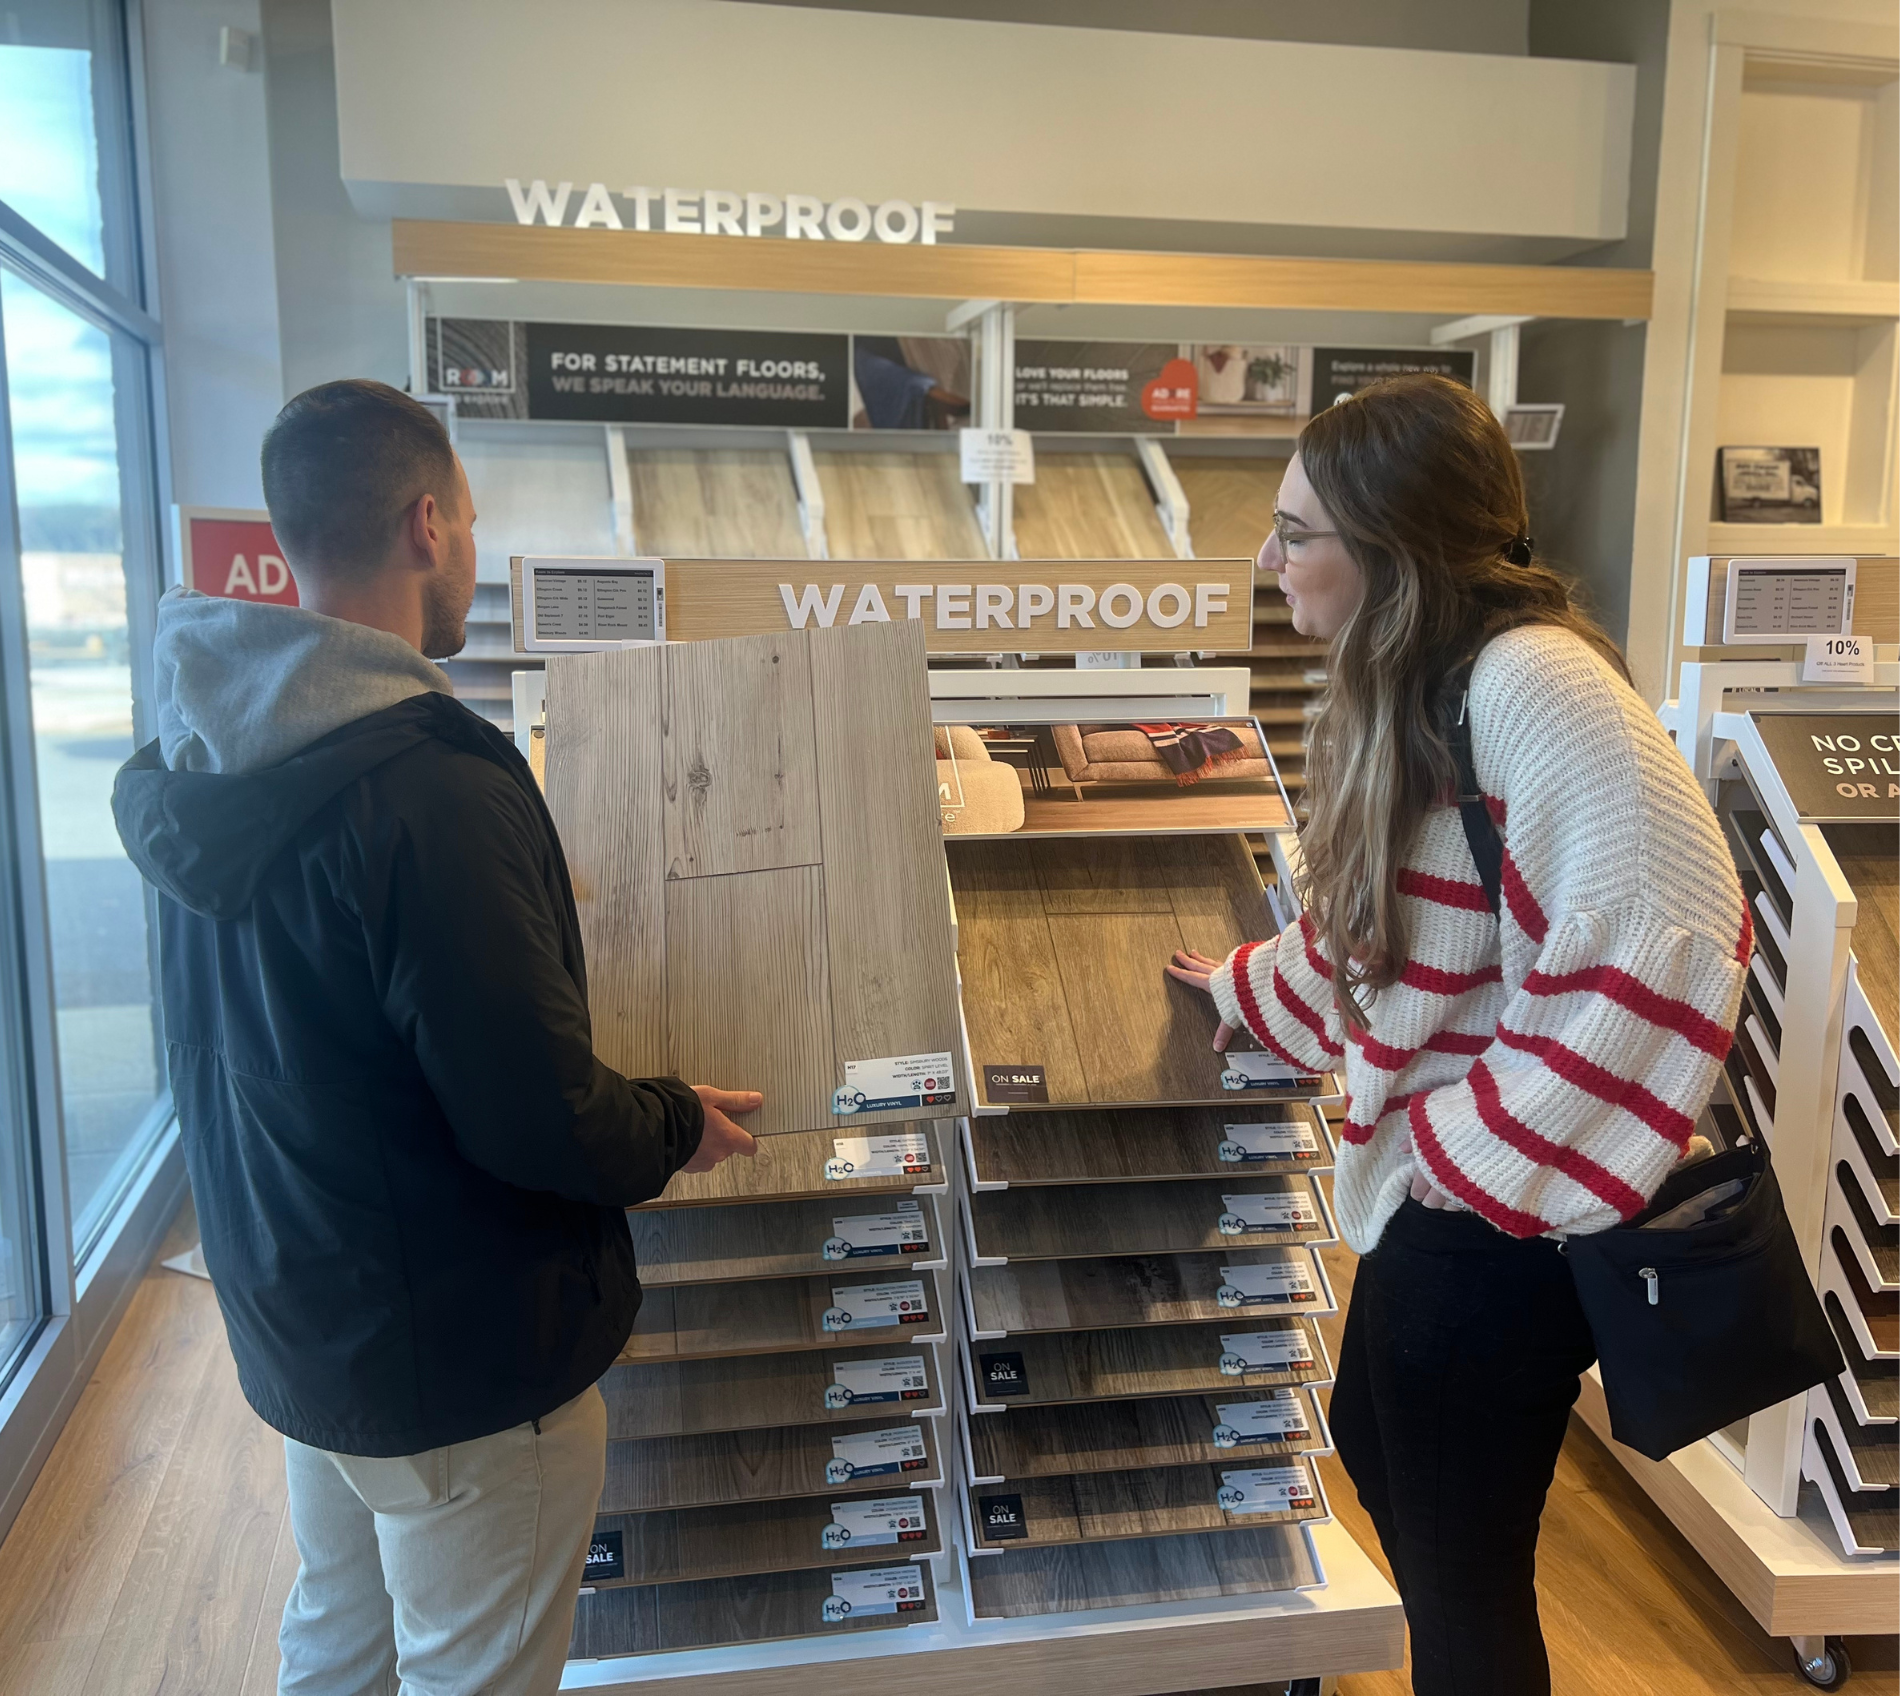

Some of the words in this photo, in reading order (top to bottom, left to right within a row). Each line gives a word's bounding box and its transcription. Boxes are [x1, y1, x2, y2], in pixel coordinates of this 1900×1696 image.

[504, 178, 956, 245] WATERPROOF
[551, 352, 596, 372] FOR
[604, 355, 727, 376] STATEMENT
[736, 359, 826, 381] FLOORS,
[1015, 367, 1046, 379] LOVE
[1049, 368, 1081, 379] YOUR
[1083, 369, 1129, 380] FLOORS
[552, 375, 586, 393] WE
[589, 376, 655, 396] SPEAK
[658, 378, 712, 397] YOUR
[717, 379, 825, 400] LANGUAGE.
[1043, 394, 1076, 406] THAT
[778, 583, 1230, 629] WATERPROOF
[1826, 640, 1860, 656] 10%
[1810, 735, 1861, 752] NO
[1836, 782, 1881, 798] OR
[992, 1074, 1009, 1083] ON
[1011, 1075, 1040, 1083] SALE
[1225, 1074, 1249, 1084] H2O
[837, 1092, 866, 1106] H2O
[1222, 1146, 1246, 1156] H2O
[829, 1163, 854, 1174] H2O
[827, 1242, 852, 1253] H2O
[827, 1312, 851, 1324] H2O
[993, 1362, 1010, 1371] ON
[990, 1371, 1018, 1380] SALE
[829, 1389, 853, 1401] H2O
[830, 1463, 854, 1476] H2O
[1221, 1491, 1244, 1502] H2O
[992, 1505, 1009, 1514] ON
[989, 1513, 1016, 1524] SALE
[826, 1529, 851, 1541] H2O
[590, 1544, 607, 1554] ON
[585, 1552, 614, 1564] SALE
[826, 1601, 851, 1614] H2O
